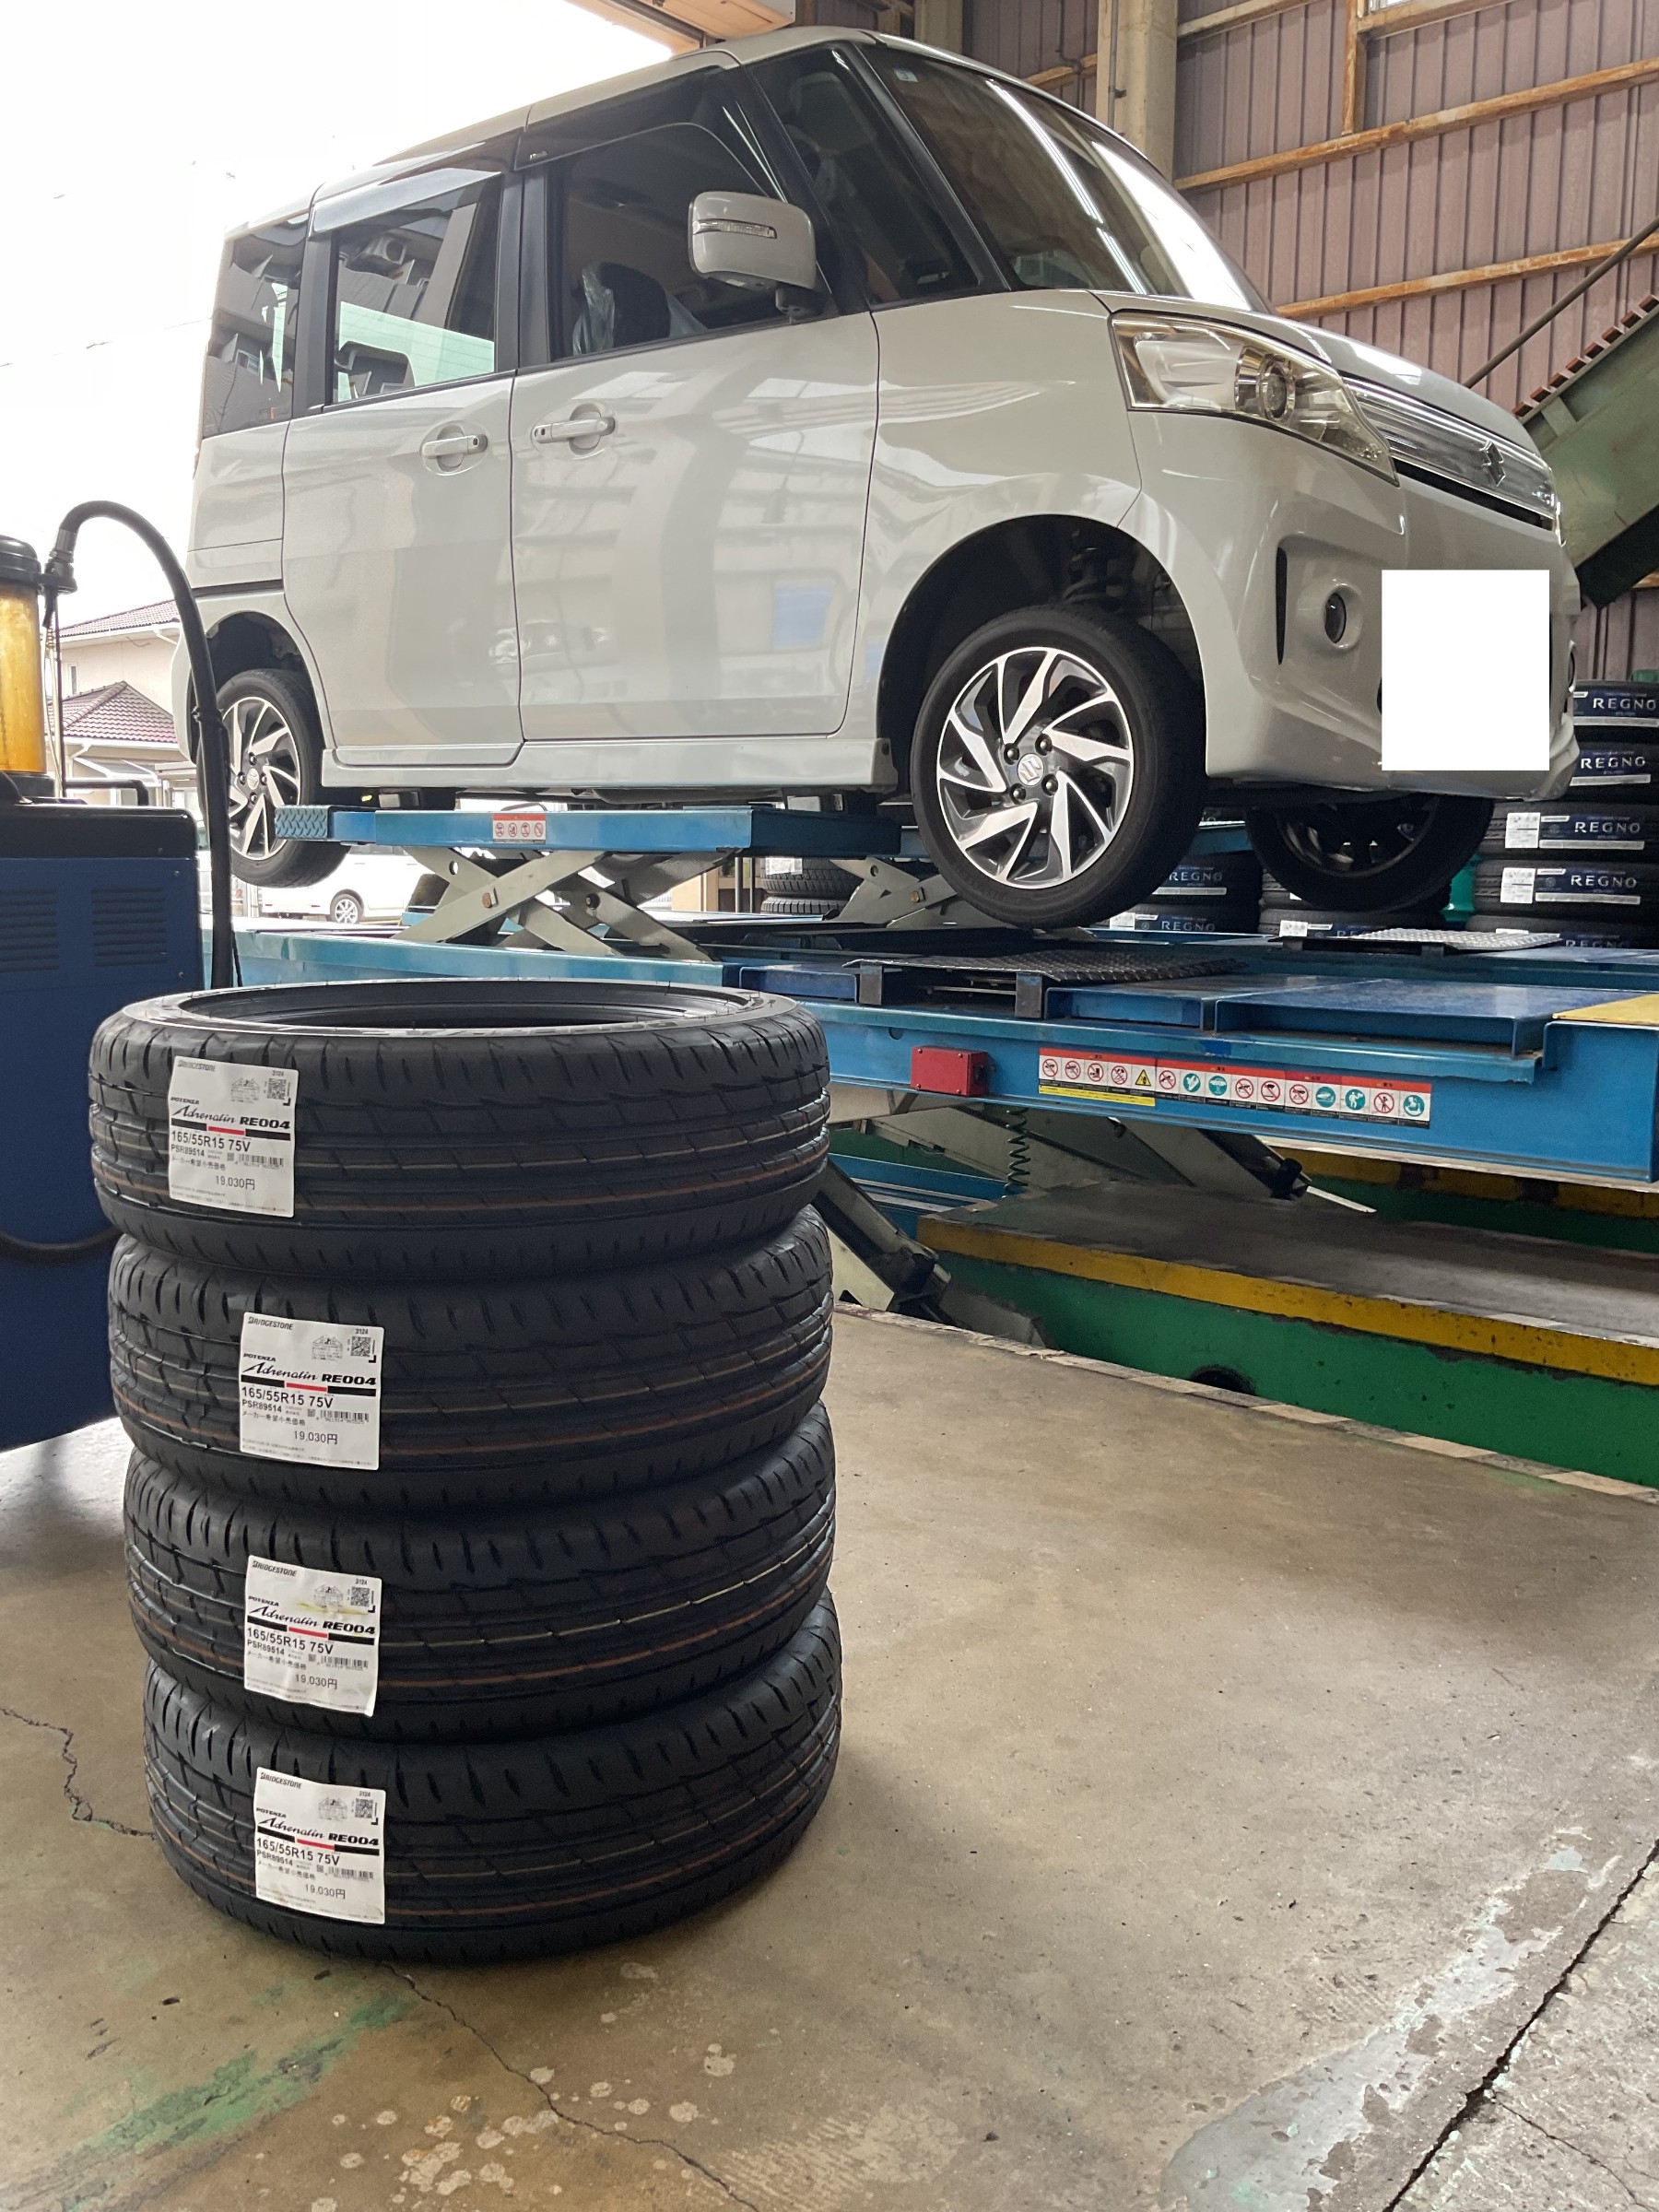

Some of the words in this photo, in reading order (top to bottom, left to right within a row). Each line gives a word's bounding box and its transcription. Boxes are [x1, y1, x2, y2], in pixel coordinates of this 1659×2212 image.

[1593, 698, 1656, 711] REGNO
[1581, 757, 1645, 770] REGNO
[1574, 821, 1641, 833] REGNO
[1169, 872, 1223, 882] REGNO
[1571, 875, 1637, 888] REGNO
[1161, 921, 1215, 932] REGNO
[171, 1096, 200, 1105] POTENZA
[172, 1105, 236, 1124] Adrenalin
[240, 1116, 290, 1130] RE004
[171, 1130, 225, 1149] 165/55R15
[229, 1139, 251, 1152] 75V
[247, 1316, 294, 1331] BRIDGESTONE
[242, 1353, 276, 1362] POTENZA
[242, 1361, 318, 1381] Adrenalin
[322, 1373, 377, 1385] RE004
[241, 1386, 305, 1406] 165/55R15
[309, 1395, 334, 1408] 75V
[242, 1399, 282, 1413] PSR89514
[252, 1560, 298, 1577] BRIDGESTONE
[248, 1595, 279, 1606] POTENZA
[249, 1606, 319, 1628] Adrenalin
[323, 1620, 375, 1635] RE004
[247, 1627, 306, 1651] 165/55R15
[310, 1641, 335, 1655] 75V
[247, 1639, 285, 1655] PSR89514
[260, 1771, 302, 1790] BRIDGESTONE
[256, 1807, 287, 1818] POTENZA
[258, 1817, 324, 1839] Adrenalin
[328, 1832, 380, 1846] RE004
[256, 1838, 313, 1861] 165/55R15
[317, 1852, 340, 1865] 75V
[256, 1850, 293, 1866] PSR89514
